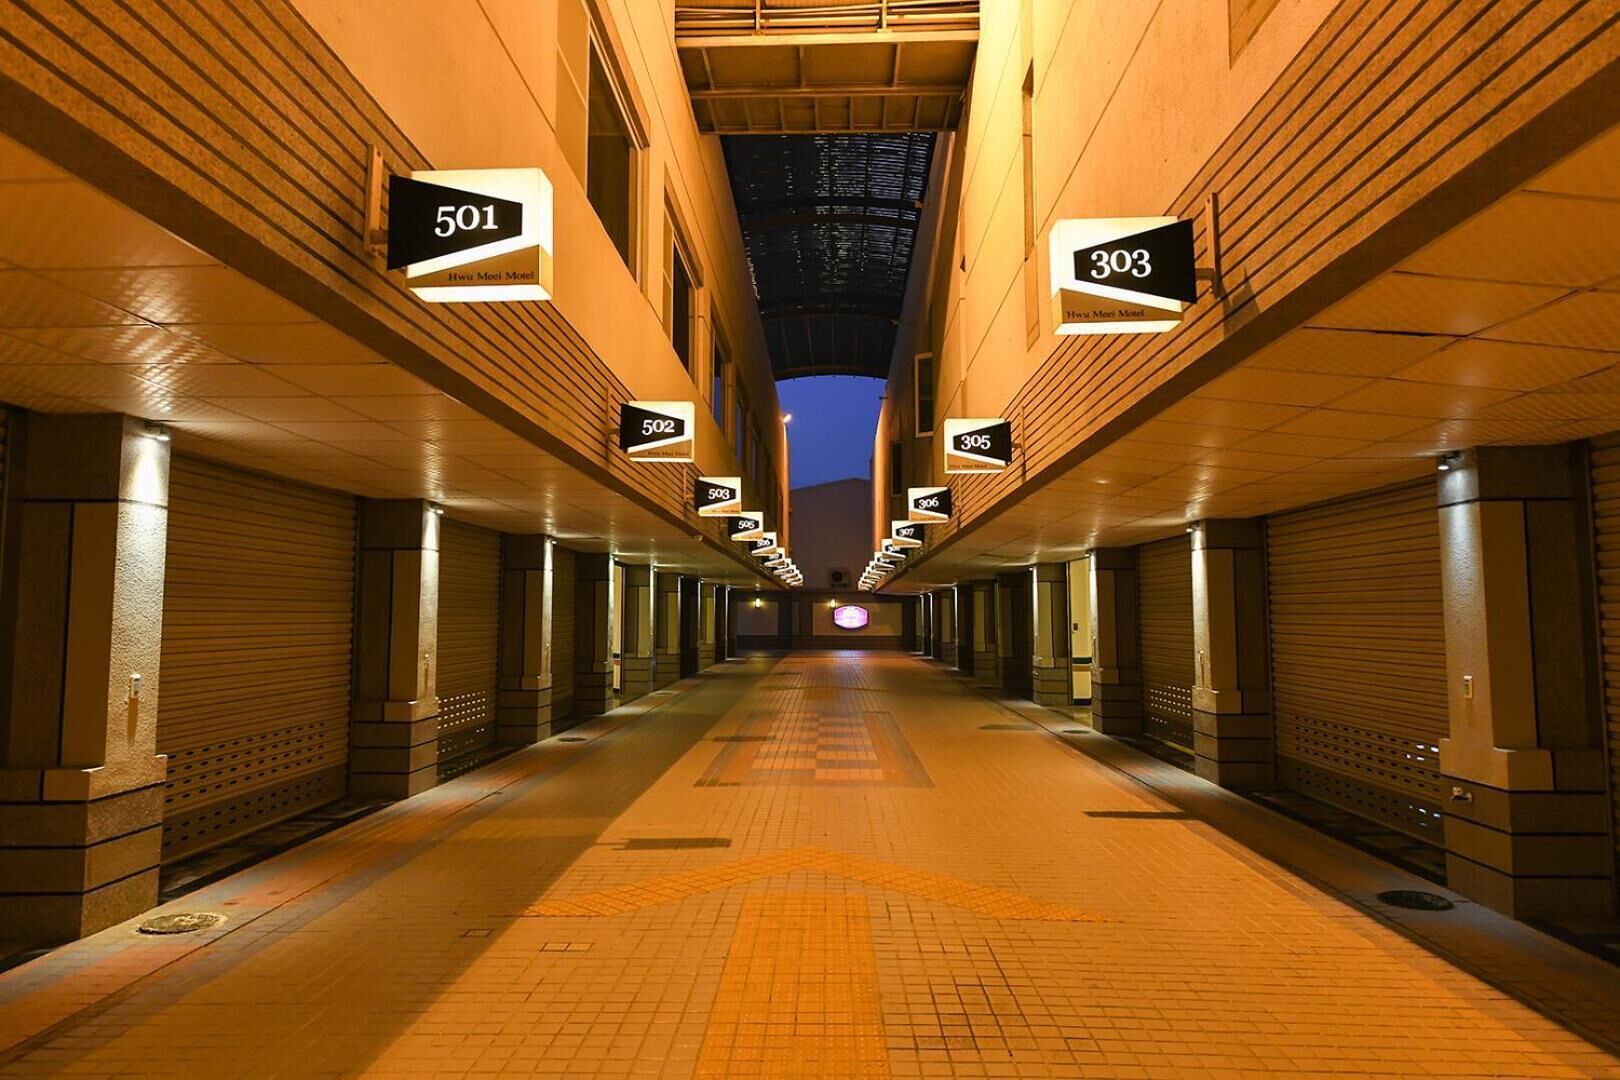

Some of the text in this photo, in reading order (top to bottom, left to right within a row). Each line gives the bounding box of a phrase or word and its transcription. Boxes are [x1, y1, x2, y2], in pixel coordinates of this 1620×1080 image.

[434, 204, 498, 237] 501
[1090, 249, 1152, 279] 303
[448, 271, 535, 281] Hwu Meei Motel
[1067, 311, 1090, 319] Hwu
[1118, 309, 1145, 318] Motel
[642, 419, 675, 435] 502
[960, 435, 991, 450] 305
[708, 488, 730, 499] 503
[918, 497, 939, 509] 306
[738, 520, 755, 529] 505
[898, 528, 915, 537] 307
